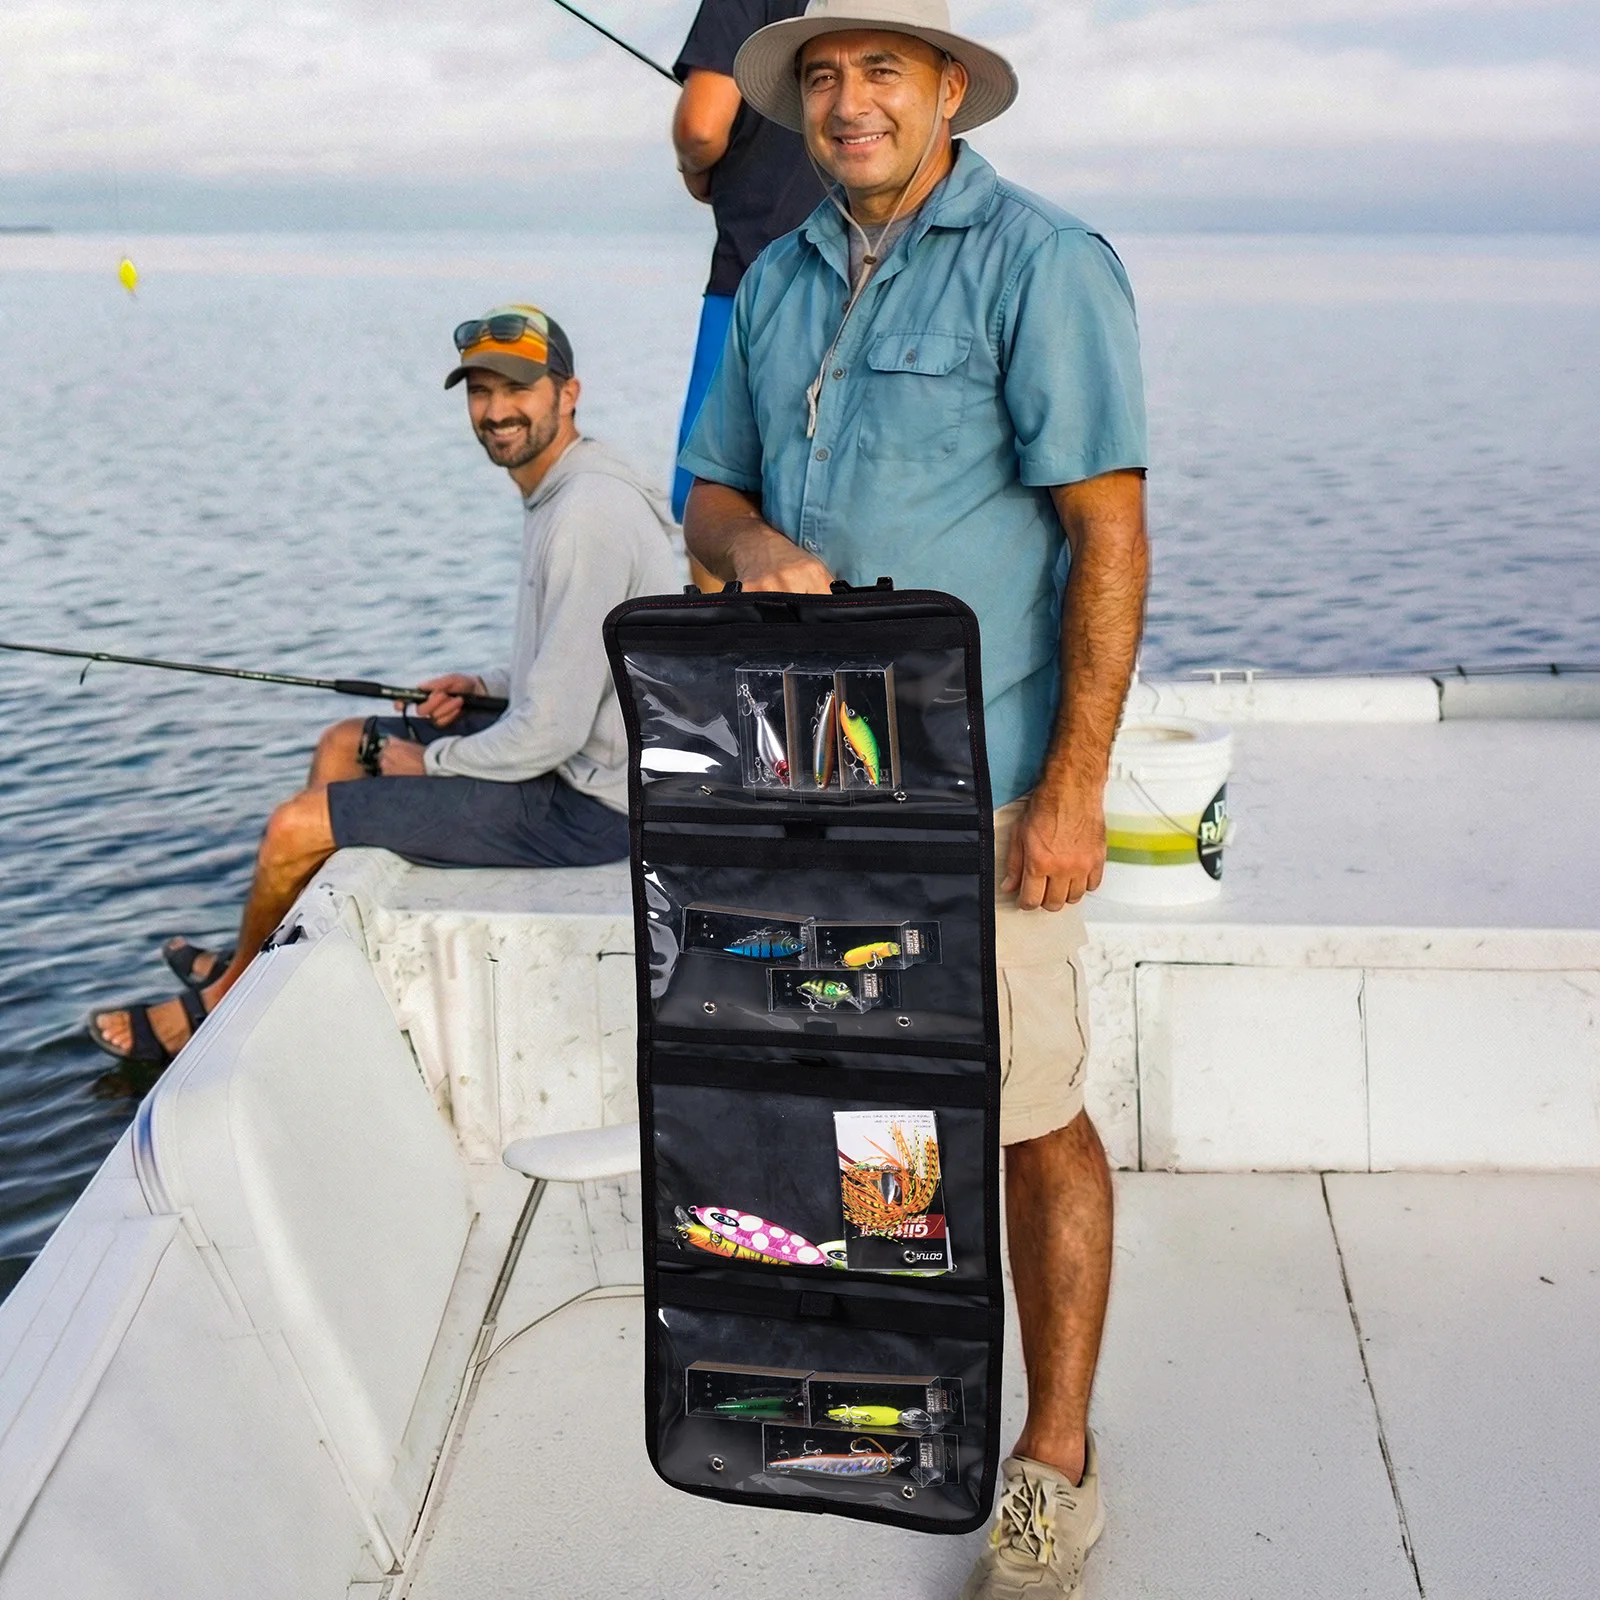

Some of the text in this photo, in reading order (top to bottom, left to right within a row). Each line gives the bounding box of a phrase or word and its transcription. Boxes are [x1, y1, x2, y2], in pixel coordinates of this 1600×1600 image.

[905, 929, 914, 954] LURE
[863, 973, 872, 998] LURE
[912, 1252, 943, 1261] GOTUR
[926, 1388, 935, 1413] LURE
[919, 1443, 928, 1468] LURE
